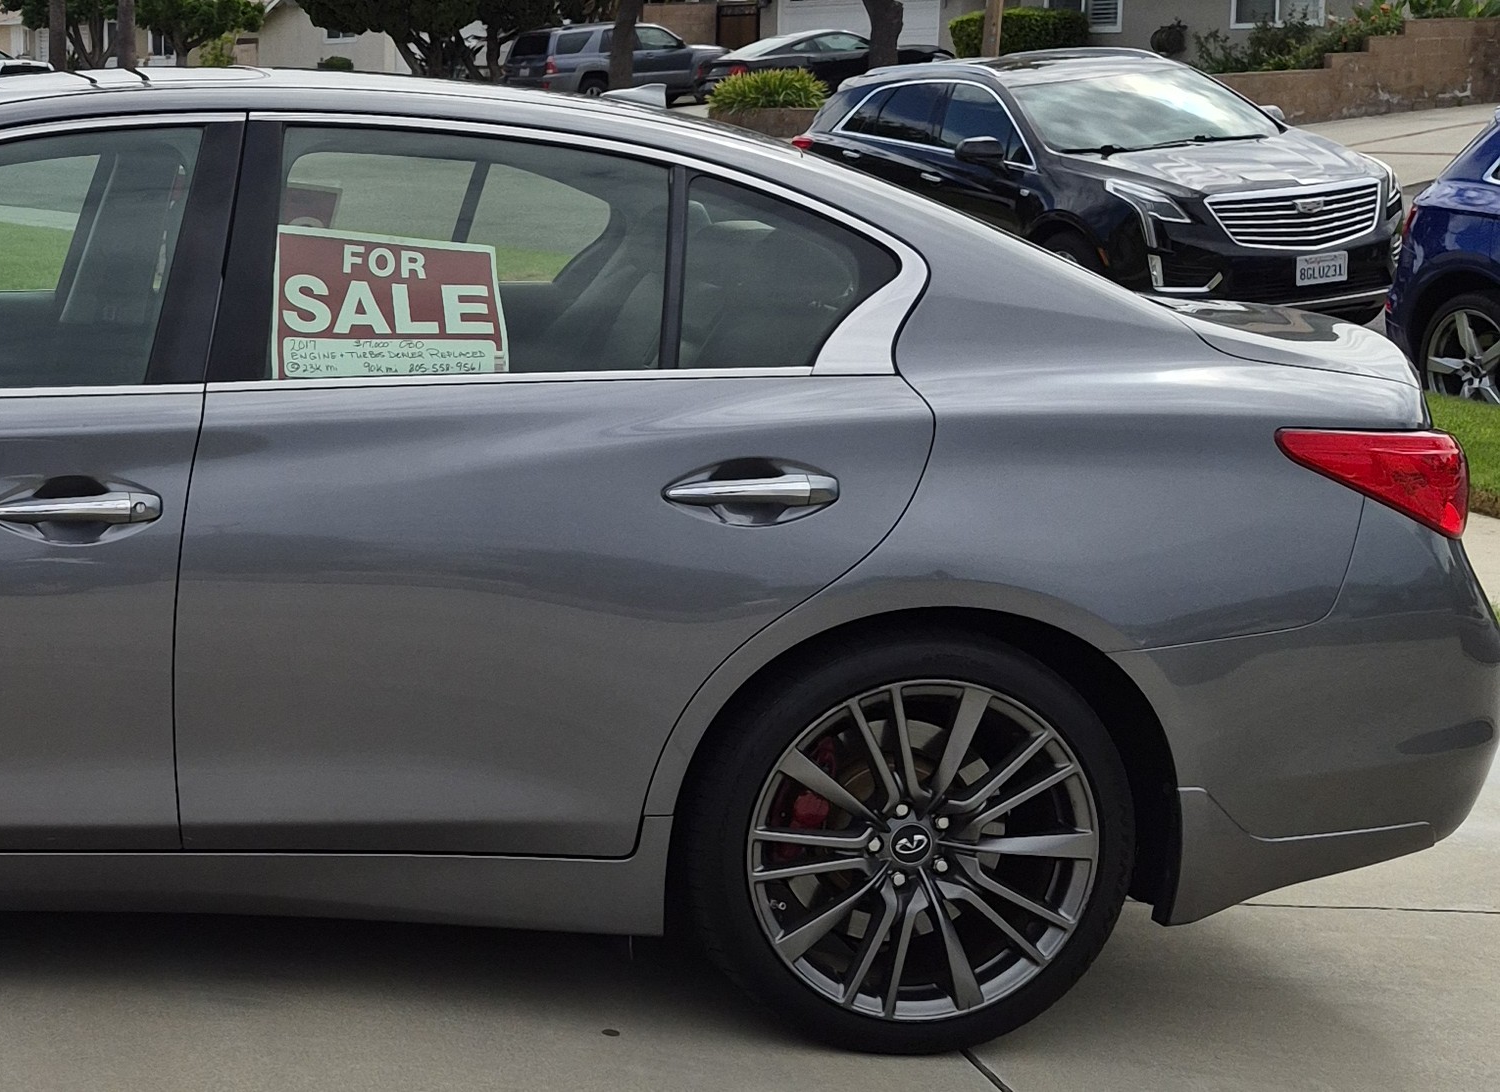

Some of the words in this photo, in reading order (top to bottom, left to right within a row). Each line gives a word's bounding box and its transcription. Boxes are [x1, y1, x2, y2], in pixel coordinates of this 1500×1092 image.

[342, 244, 427, 279] FOR
[1299, 263, 1343, 281] 8GLU231
[282, 274, 495, 335] SALE
[290, 339, 317, 351] 2017
[290, 351, 337, 361] ENGINE
